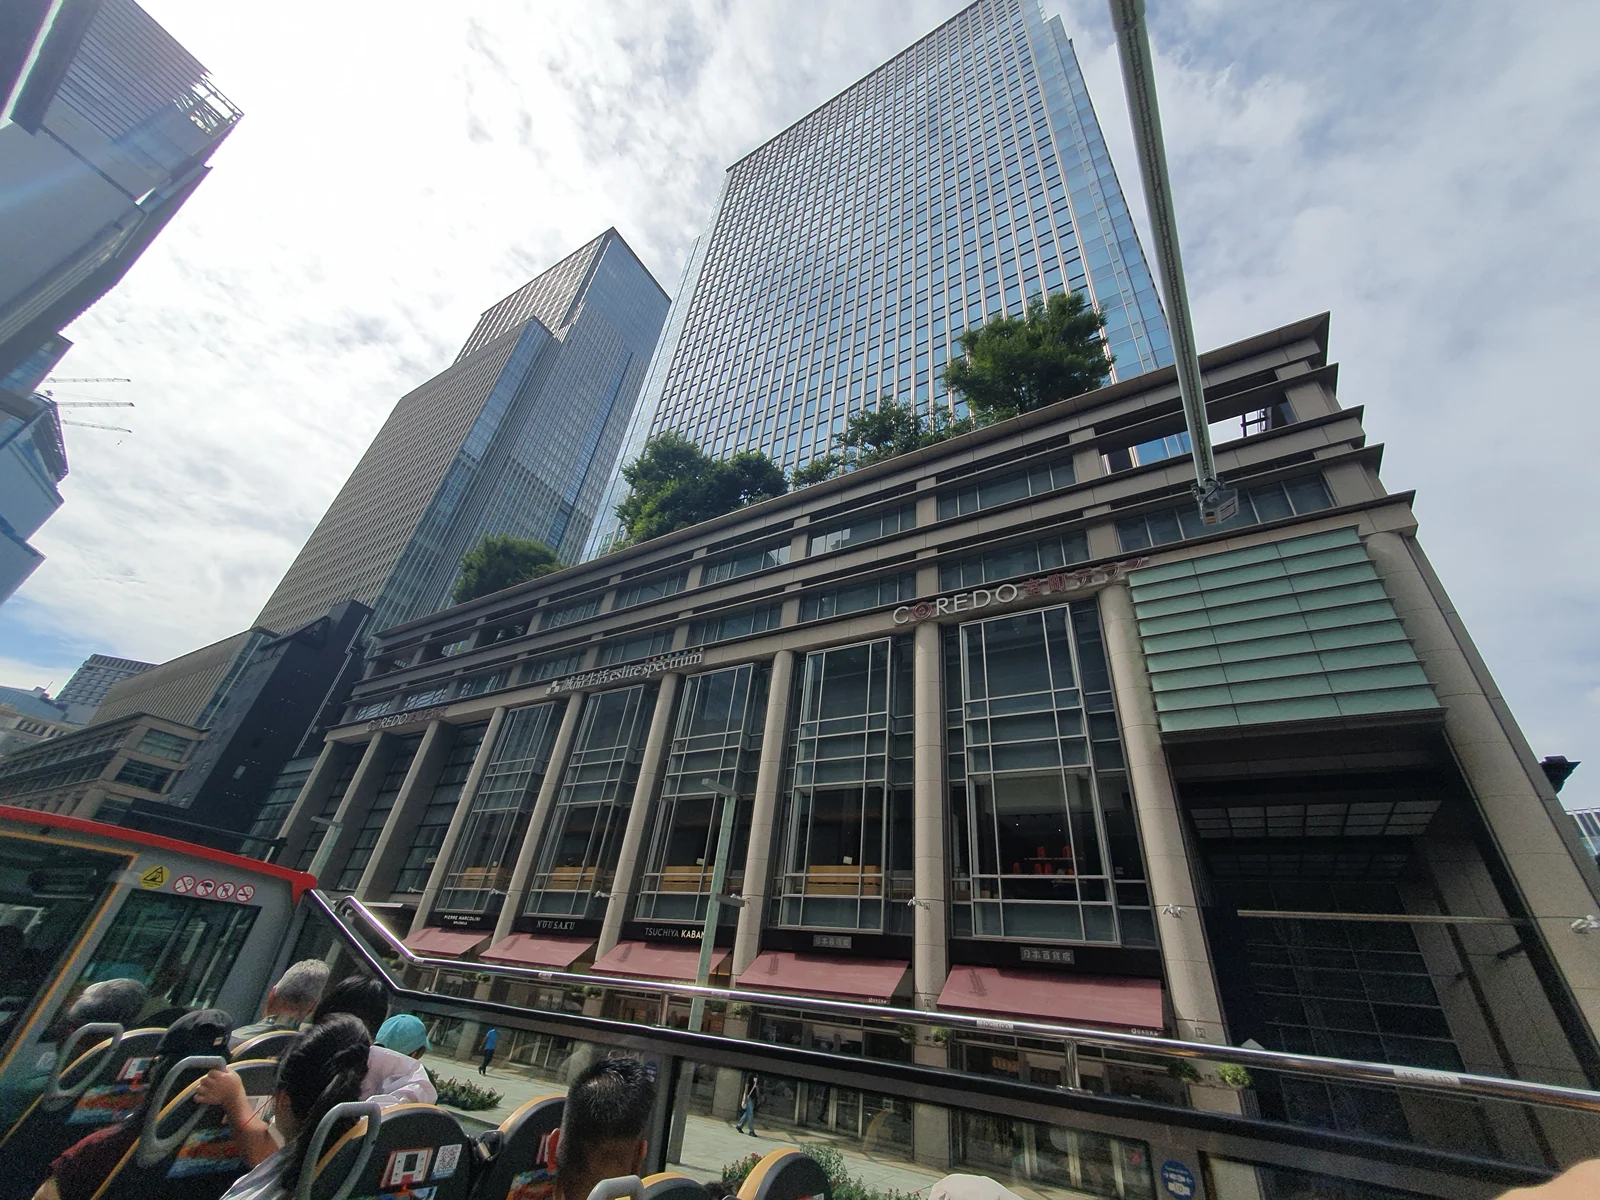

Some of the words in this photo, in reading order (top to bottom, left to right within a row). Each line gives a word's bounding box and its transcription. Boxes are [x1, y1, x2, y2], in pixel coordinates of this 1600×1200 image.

[892, 583, 1018, 625] COREDO
[609, 664, 641, 682] eslite
[642, 651, 703, 679] spectrum
[366, 713, 408, 732] COREDO
[536, 920, 576, 930] NOUSAKU
[644, 927, 679, 938] TSUCHIYA
